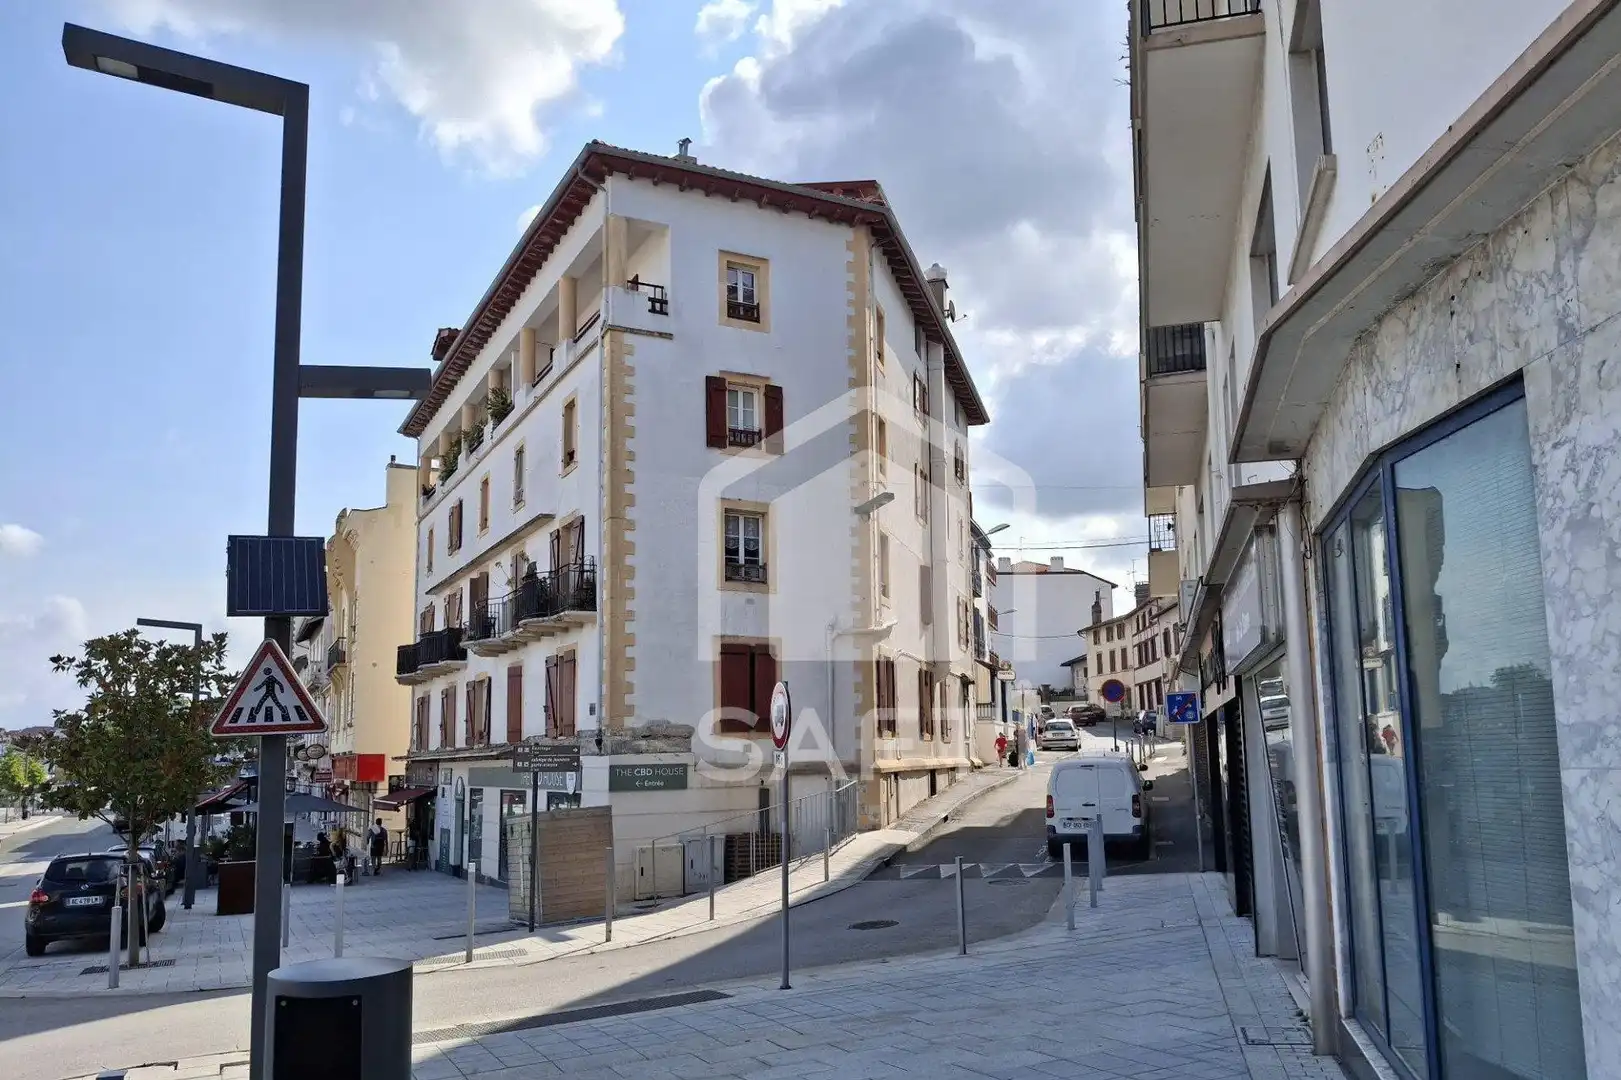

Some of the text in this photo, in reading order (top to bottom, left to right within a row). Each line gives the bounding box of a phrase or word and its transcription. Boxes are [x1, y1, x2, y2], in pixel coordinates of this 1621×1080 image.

[615, 767, 684, 777] THE CBD HOUSE
